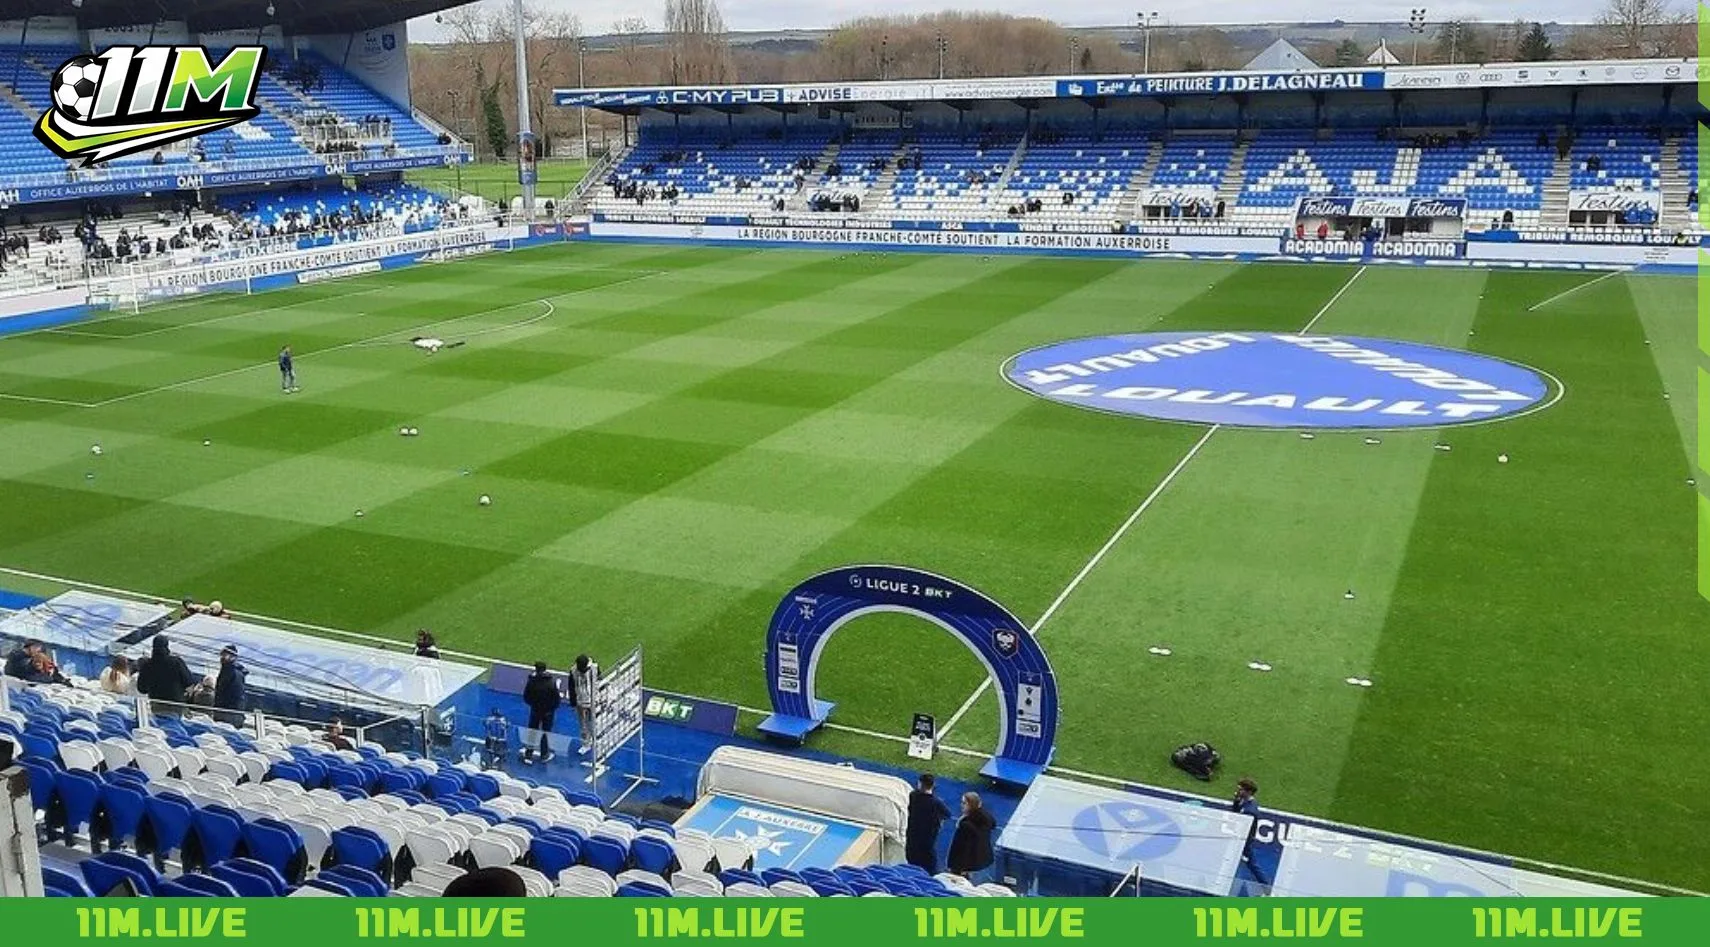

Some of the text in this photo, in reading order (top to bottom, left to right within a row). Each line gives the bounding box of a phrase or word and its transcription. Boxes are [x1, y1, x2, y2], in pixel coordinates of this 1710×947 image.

[1146, 77, 1213, 92] PEINTURE
[1216, 72, 1364, 91] J.DELAGNEAU
[731, 89, 779, 103] PUB
[798, 87, 851, 101] ADVISE
[325, 163, 347, 175] OAH
[176, 174, 204, 188] OAH
[210, 173, 237, 184] OFFICE
[30, 187, 62, 199] OFFICE
[64, 182, 115, 196] AUXERROIS
[116, 180, 128, 192] DE
[738, 229, 750, 239] LA
[791, 230, 852, 241] BOURGOGNE
[946, 234, 999, 246] SOUTIENT
[1006, 235, 1021, 246] LA
[1024, 236, 1091, 248] FORMATION
[1095, 237, 1171, 250] AUXERROISE
[1518, 231, 1567, 242] TRIBUNE
[1570, 232, 1644, 243] REMORQUES
[1285, 240, 1364, 255] ACADOMIA
[1372, 241, 1457, 256] ACADOMIA
[1047, 382, 1503, 418] LOUAULT
[866, 577, 953, 599] LIGUE 2 BKT
[645, 698, 694, 722] BKT
